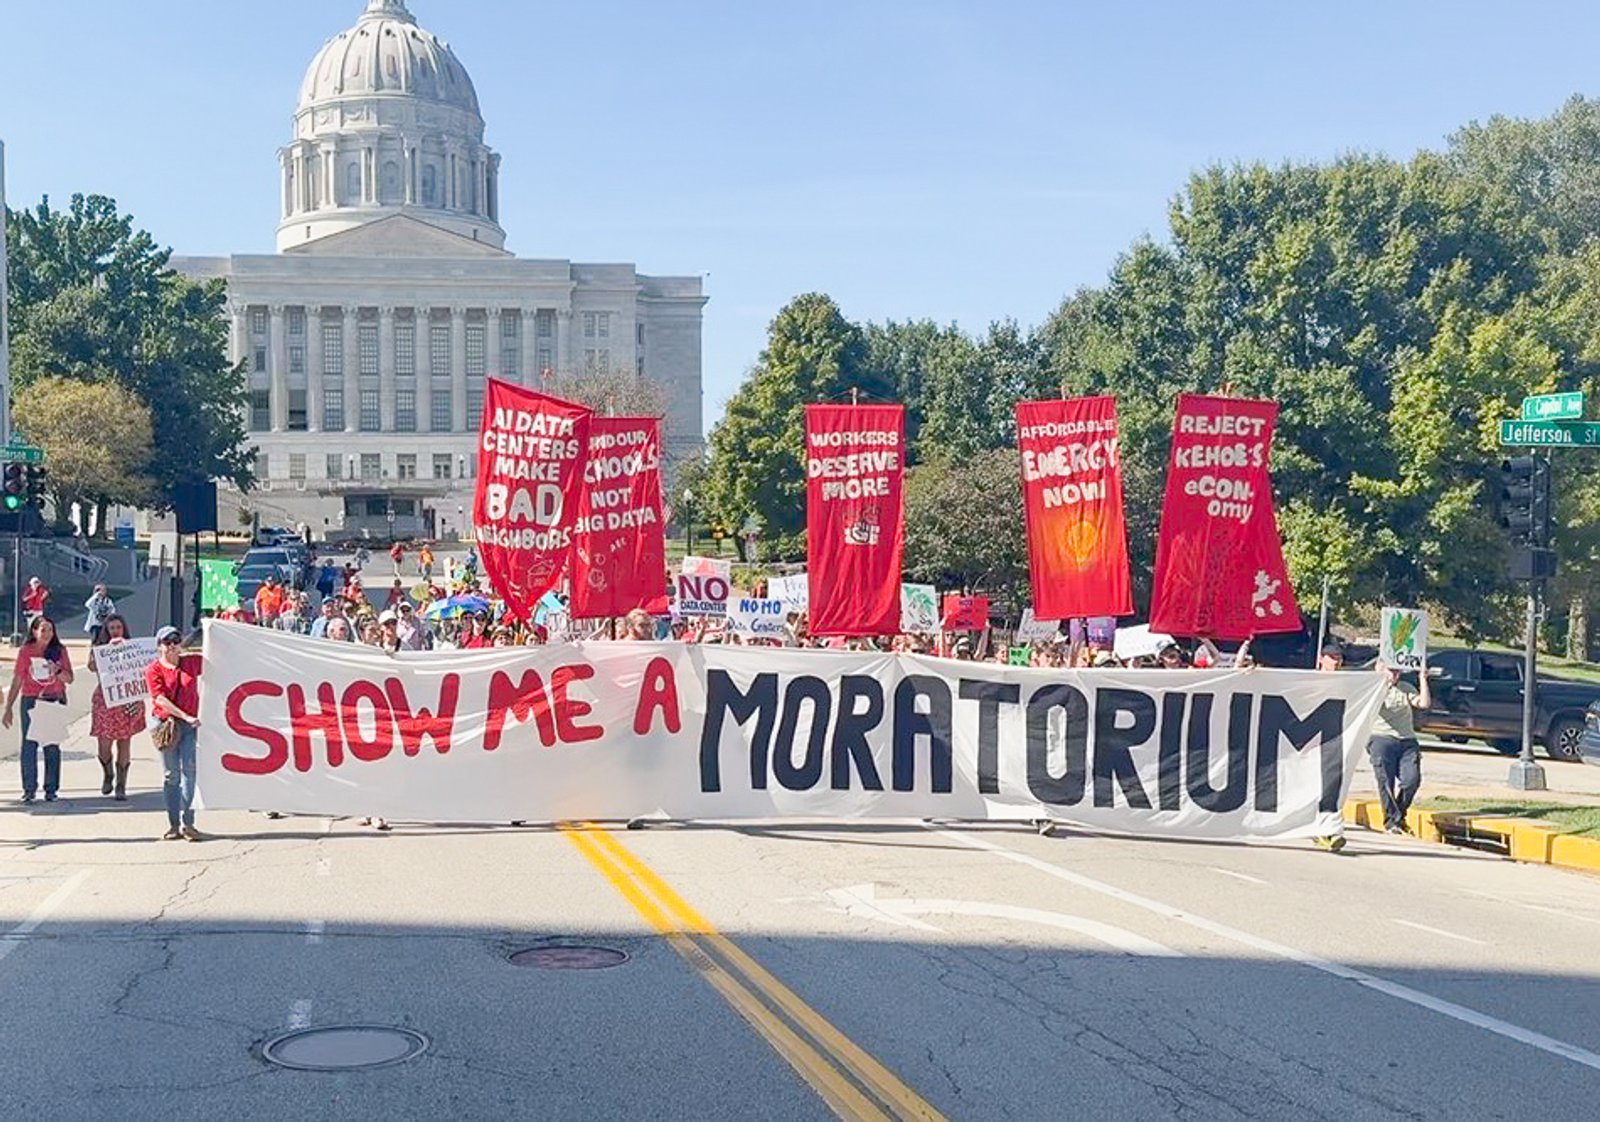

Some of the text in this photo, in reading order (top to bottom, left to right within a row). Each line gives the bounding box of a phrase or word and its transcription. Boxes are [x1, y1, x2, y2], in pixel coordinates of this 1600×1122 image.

[492, 408, 575, 438] AI DATA
[1020, 419, 1114, 440] AFFORDABLE
[1180, 414, 1265, 437] REJECT
[1504, 424, 1596, 443] Jefferson St
[483, 430, 580, 460] CENTERS
[810, 431, 899, 448] WORKERS
[494, 455, 561, 481] MAKE
[808, 451, 900, 478] DESERVE
[1022, 437, 1118, 482] ENERGY
[591, 487, 631, 509] NOT
[822, 476, 890, 501] MORE
[486, 483, 565, 527] BAD
[1207, 499, 1253, 525] omy
[607, 507, 657, 531] DATA
[678, 575, 729, 602] NO
[740, 599, 782, 615] NO MO
[221, 656, 1346, 814] SHOW ME A MORATORIUM
